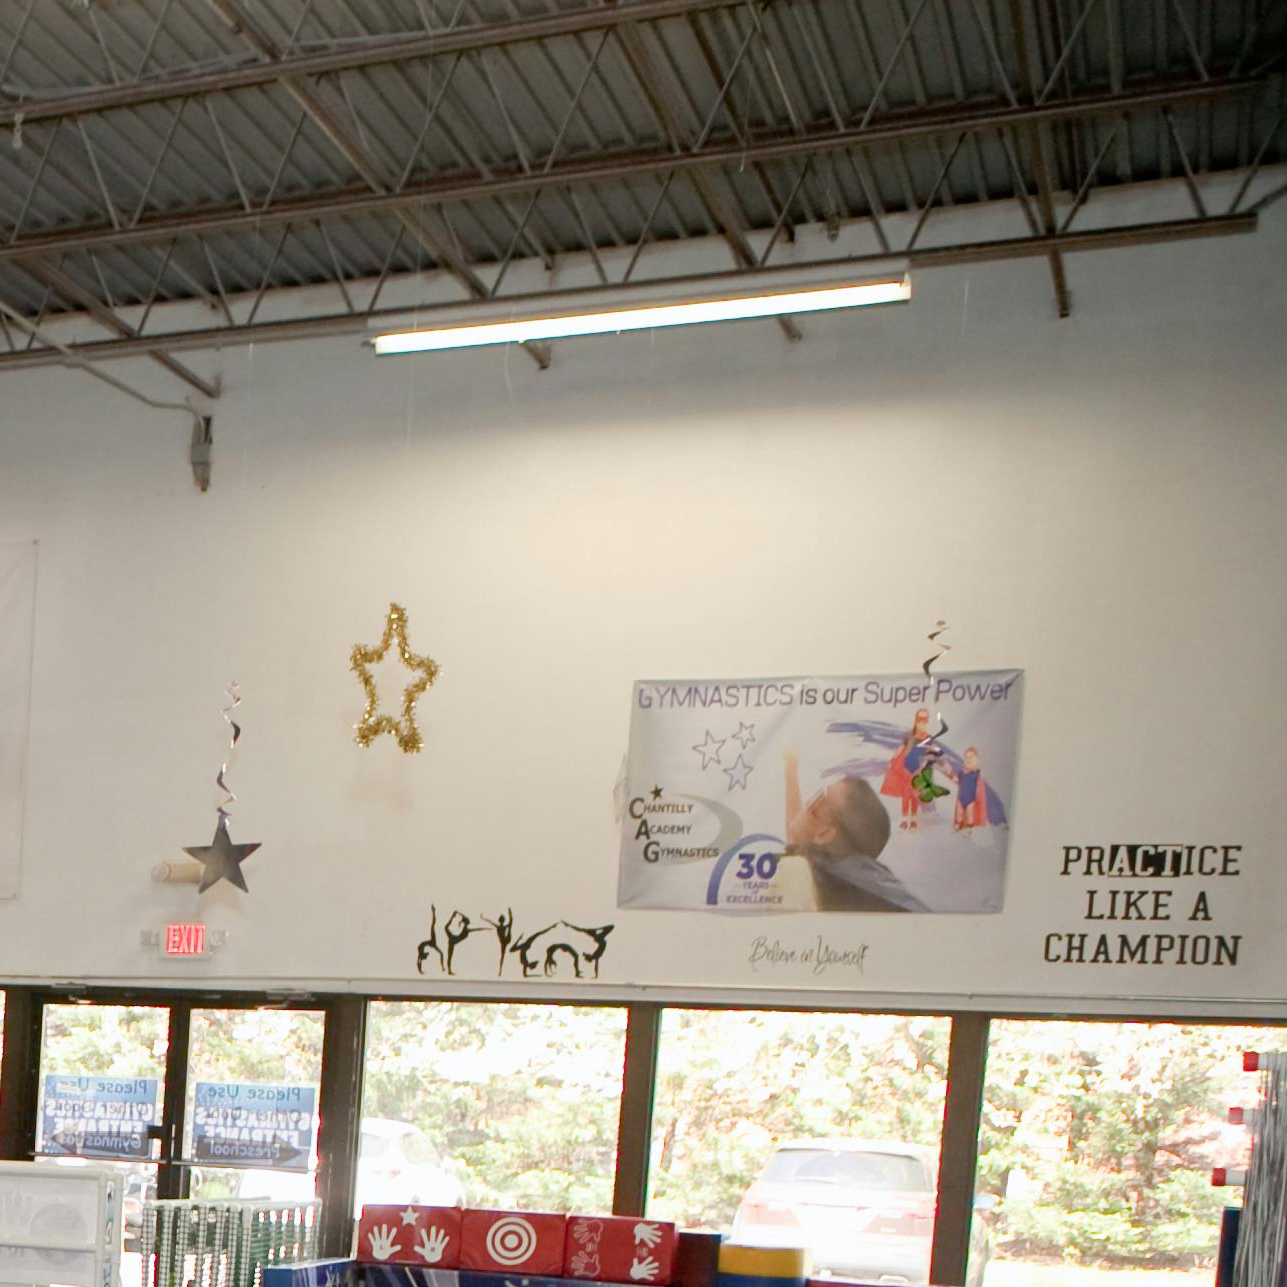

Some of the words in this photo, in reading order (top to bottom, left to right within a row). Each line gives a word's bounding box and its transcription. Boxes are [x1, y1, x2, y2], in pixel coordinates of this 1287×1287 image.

[637, 684, 794, 709] GYMNASTICS
[799, 684, 818, 706] is
[821, 686, 858, 706] our
[863, 681, 928, 711] Super
[934, 679, 1014, 705] Power
[628, 797, 694, 819] CHANTILLY
[634, 819, 693, 841] ACADEMY
[643, 841, 721, 863] GYMNASTICS
[1060, 844, 1243, 877] PRACTICE
[736, 853, 778, 880] 30
[726, 896, 783, 905] EXCELLENCE
[1084, 890, 1173, 921] LIKE
[1188, 891, 1213, 921] A
[166, 924, 206, 954] EXIT
[1044, 933, 1243, 966] CHAMPION
